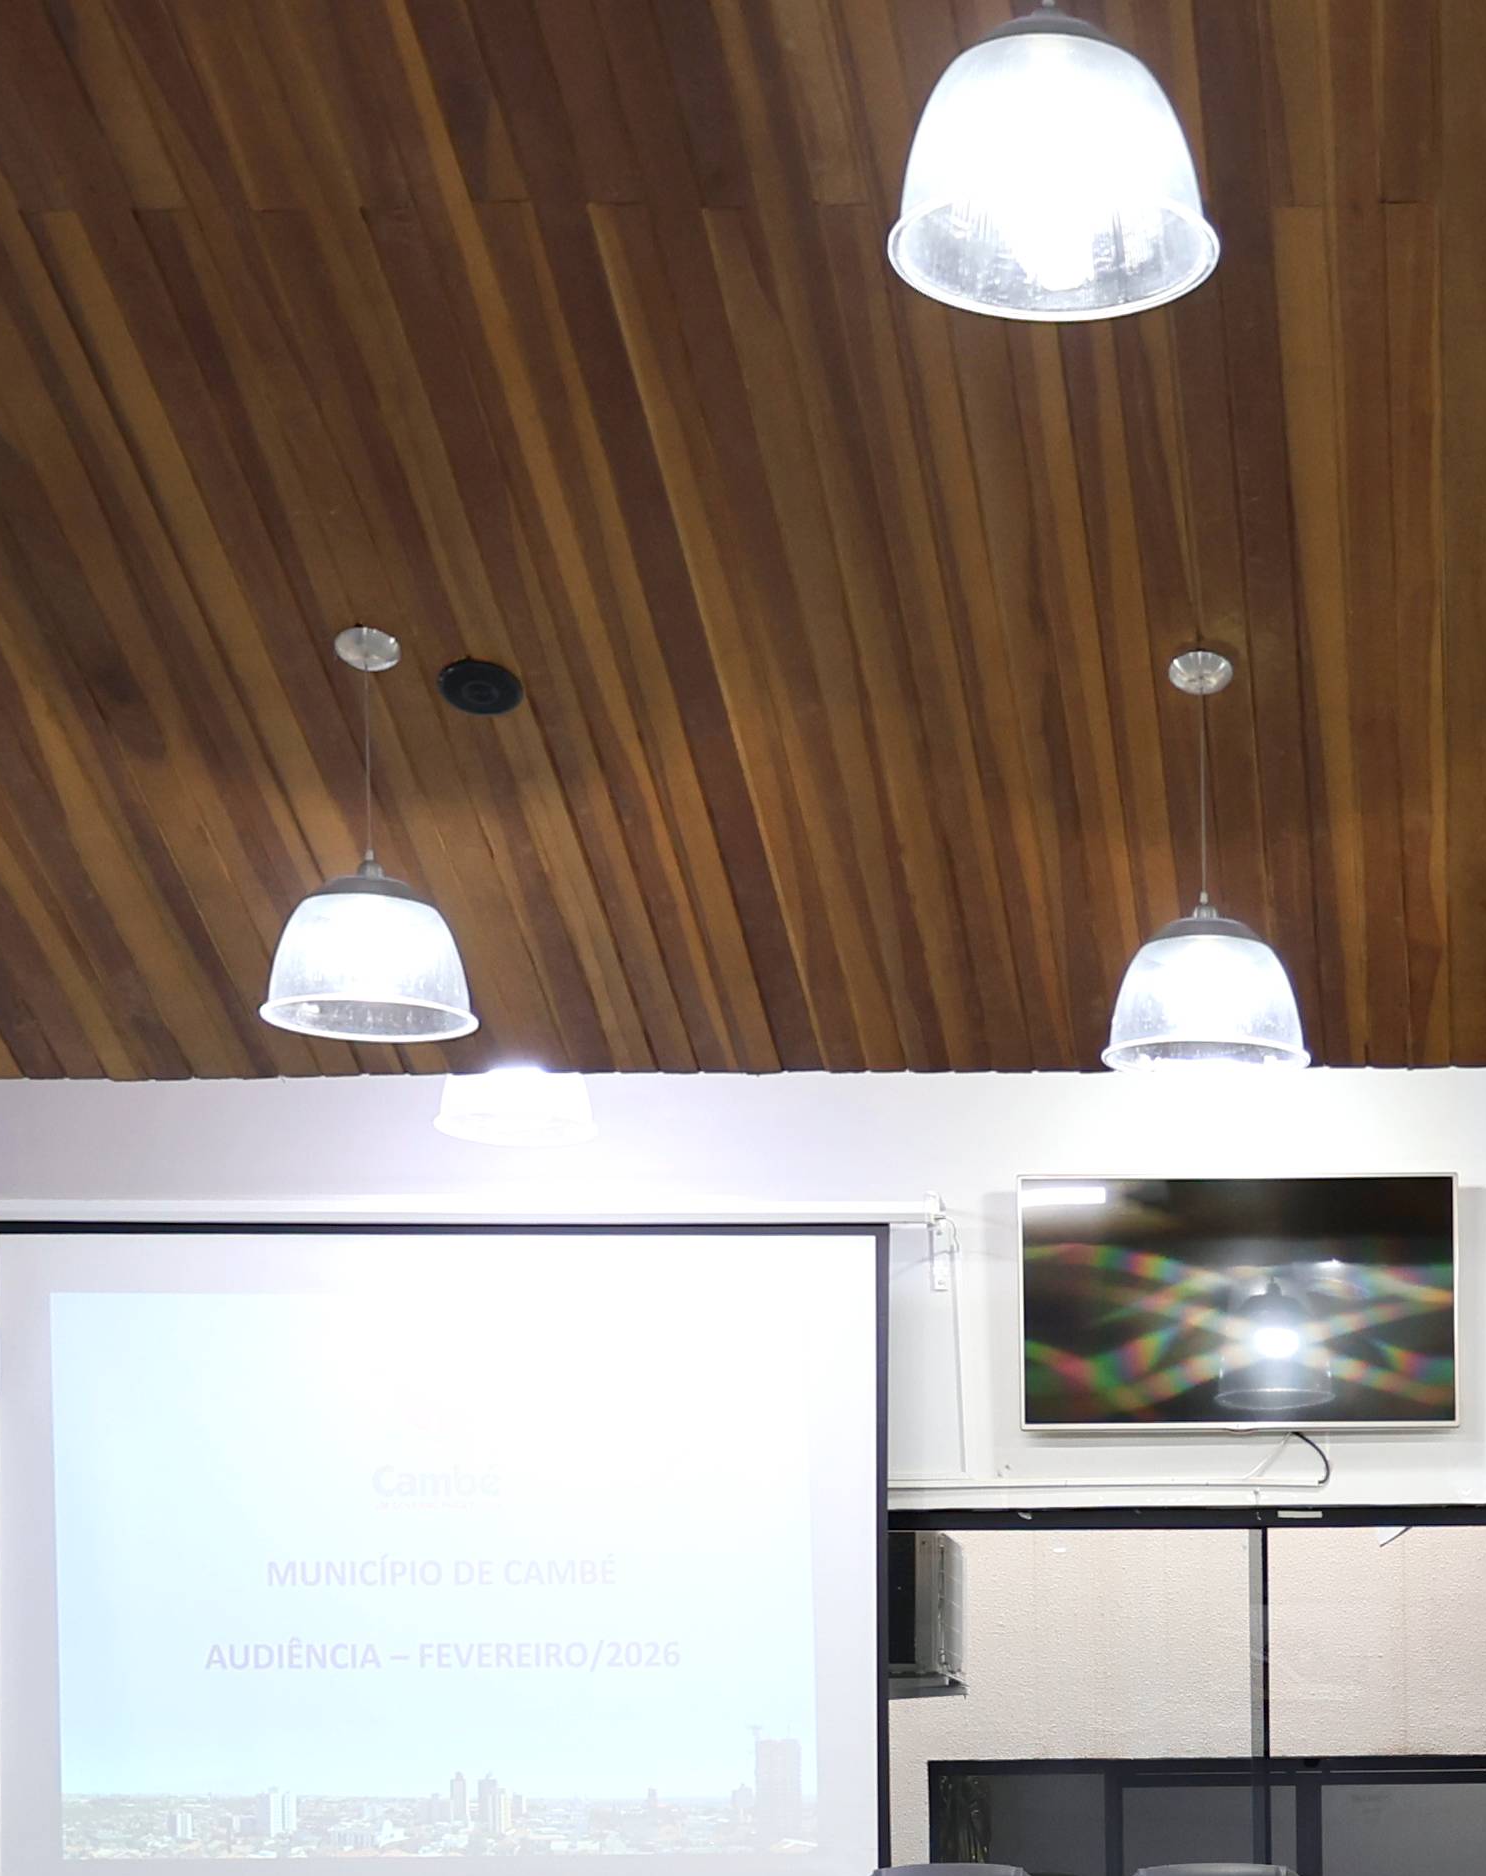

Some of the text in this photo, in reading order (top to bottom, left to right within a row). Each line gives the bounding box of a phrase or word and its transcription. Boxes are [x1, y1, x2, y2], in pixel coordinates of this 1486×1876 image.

[267, 1552, 617, 1588] MUNICÍPIO DE CAMBÉ
[204, 1635, 382, 1671] AUDIÊNCIA
[418, 1639, 682, 1673] FEVEREIRO/2026
